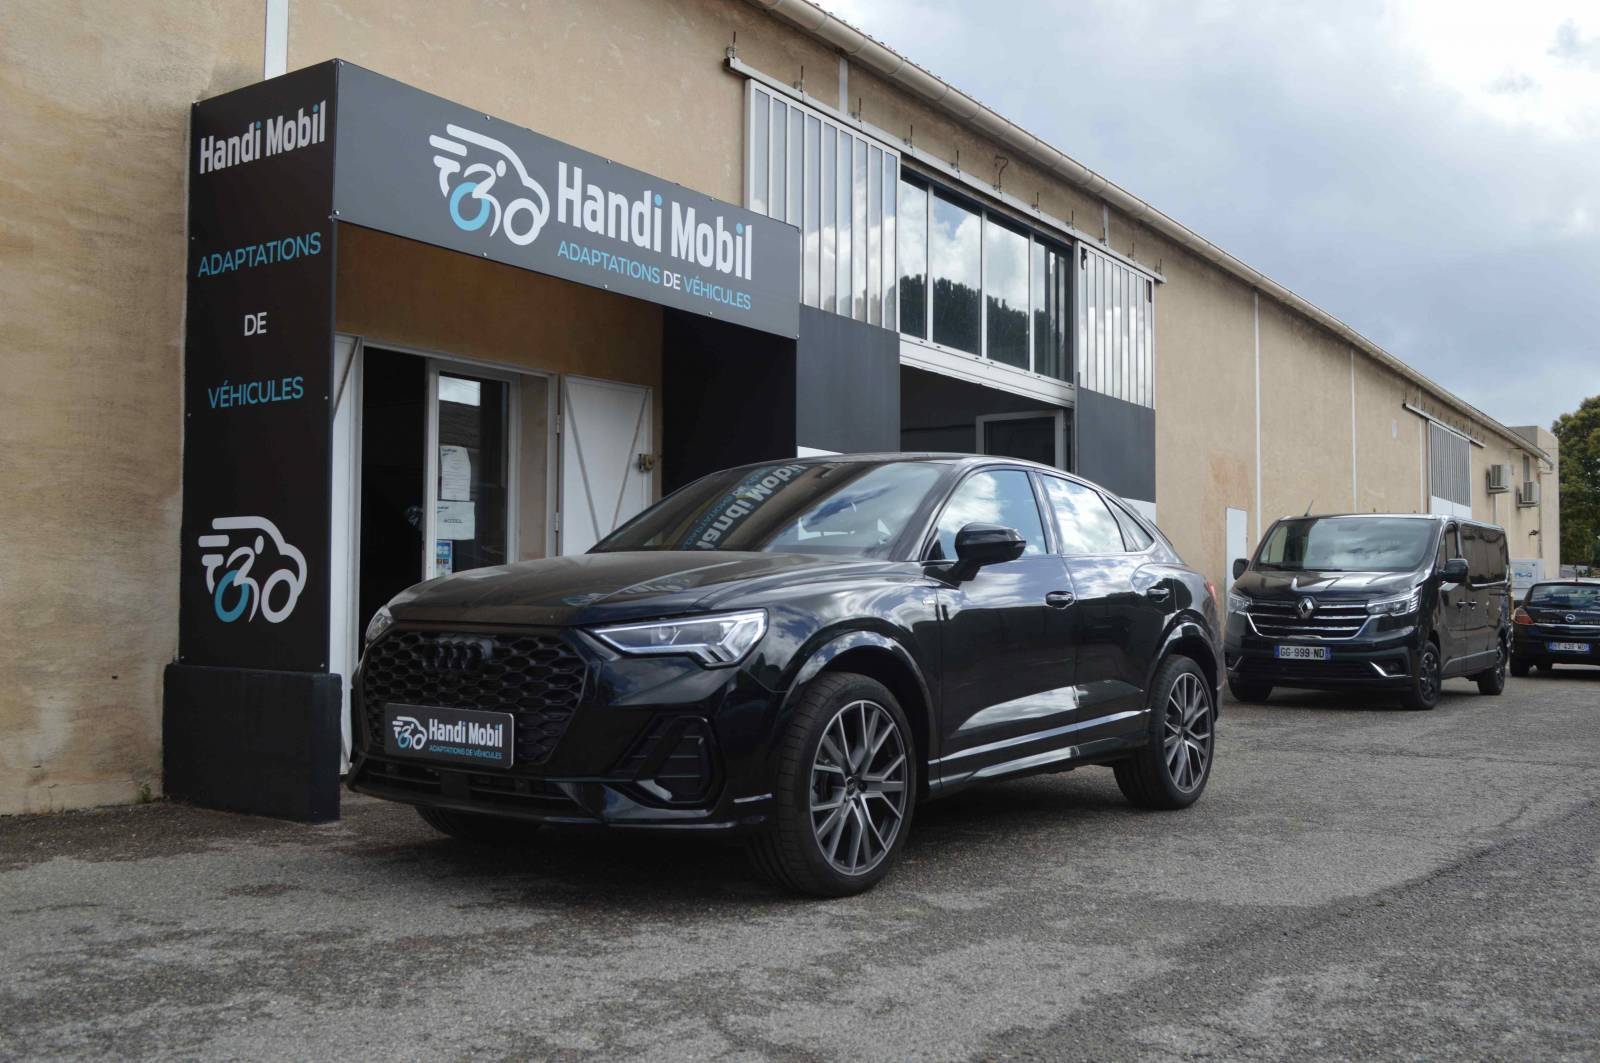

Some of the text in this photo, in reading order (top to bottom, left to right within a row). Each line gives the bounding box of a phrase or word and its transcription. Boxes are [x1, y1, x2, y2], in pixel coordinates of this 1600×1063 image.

[199, 100, 327, 174] Handi Mobil
[557, 161, 753, 281] Handi Mobil
[198, 232, 322, 278] ADAPTATIONS
[557, 241, 752, 310] ADAPTATIONS DE VÉHICULES
[243, 312, 268, 336] DE
[208, 376, 305, 409] VÉHICULES
[429, 718, 503, 748] Handi Mobil
